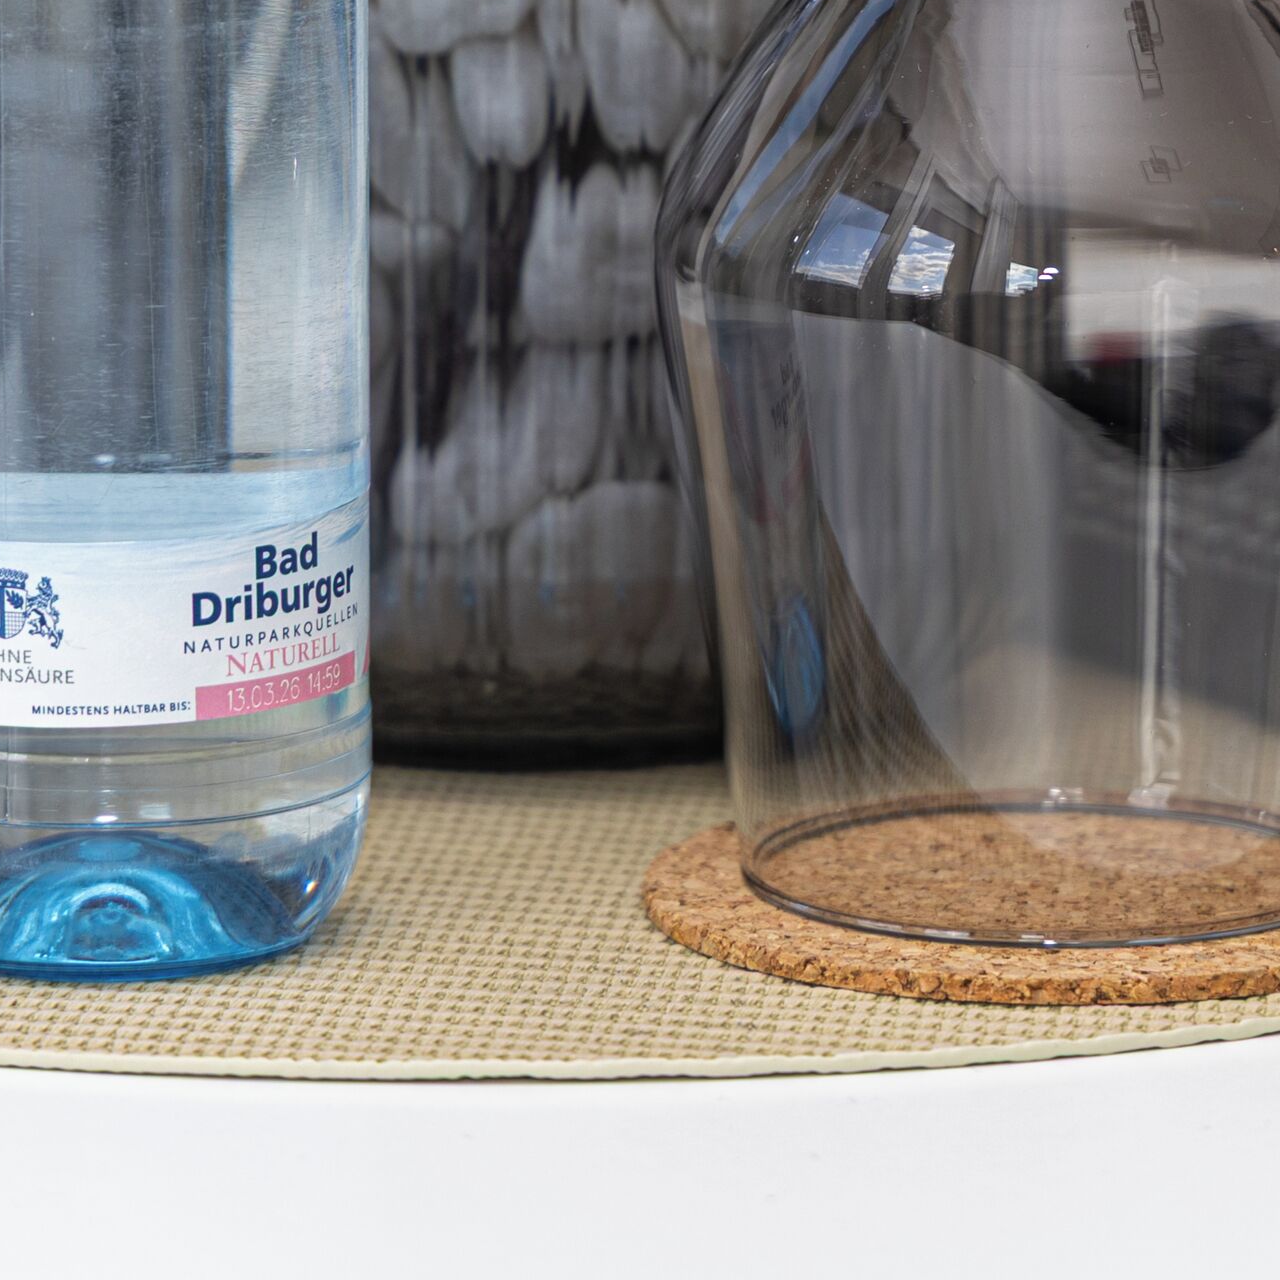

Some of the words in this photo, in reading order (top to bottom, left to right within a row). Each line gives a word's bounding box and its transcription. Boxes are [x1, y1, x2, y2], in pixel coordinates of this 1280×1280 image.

[255, 531, 318, 580] Bad
[192, 565, 354, 627] Driburger
[183, 602, 359, 654] NATURPARKQUELLEN
[226, 632, 341, 677] NATURELL
[31, 704, 109, 716] MINDESTENS
[113, 702, 166, 715] HALTBAR
[169, 700, 191, 711] BIS:
[227, 676, 300, 712] 13.03.26
[307, 663, 341, 693] 14:59
